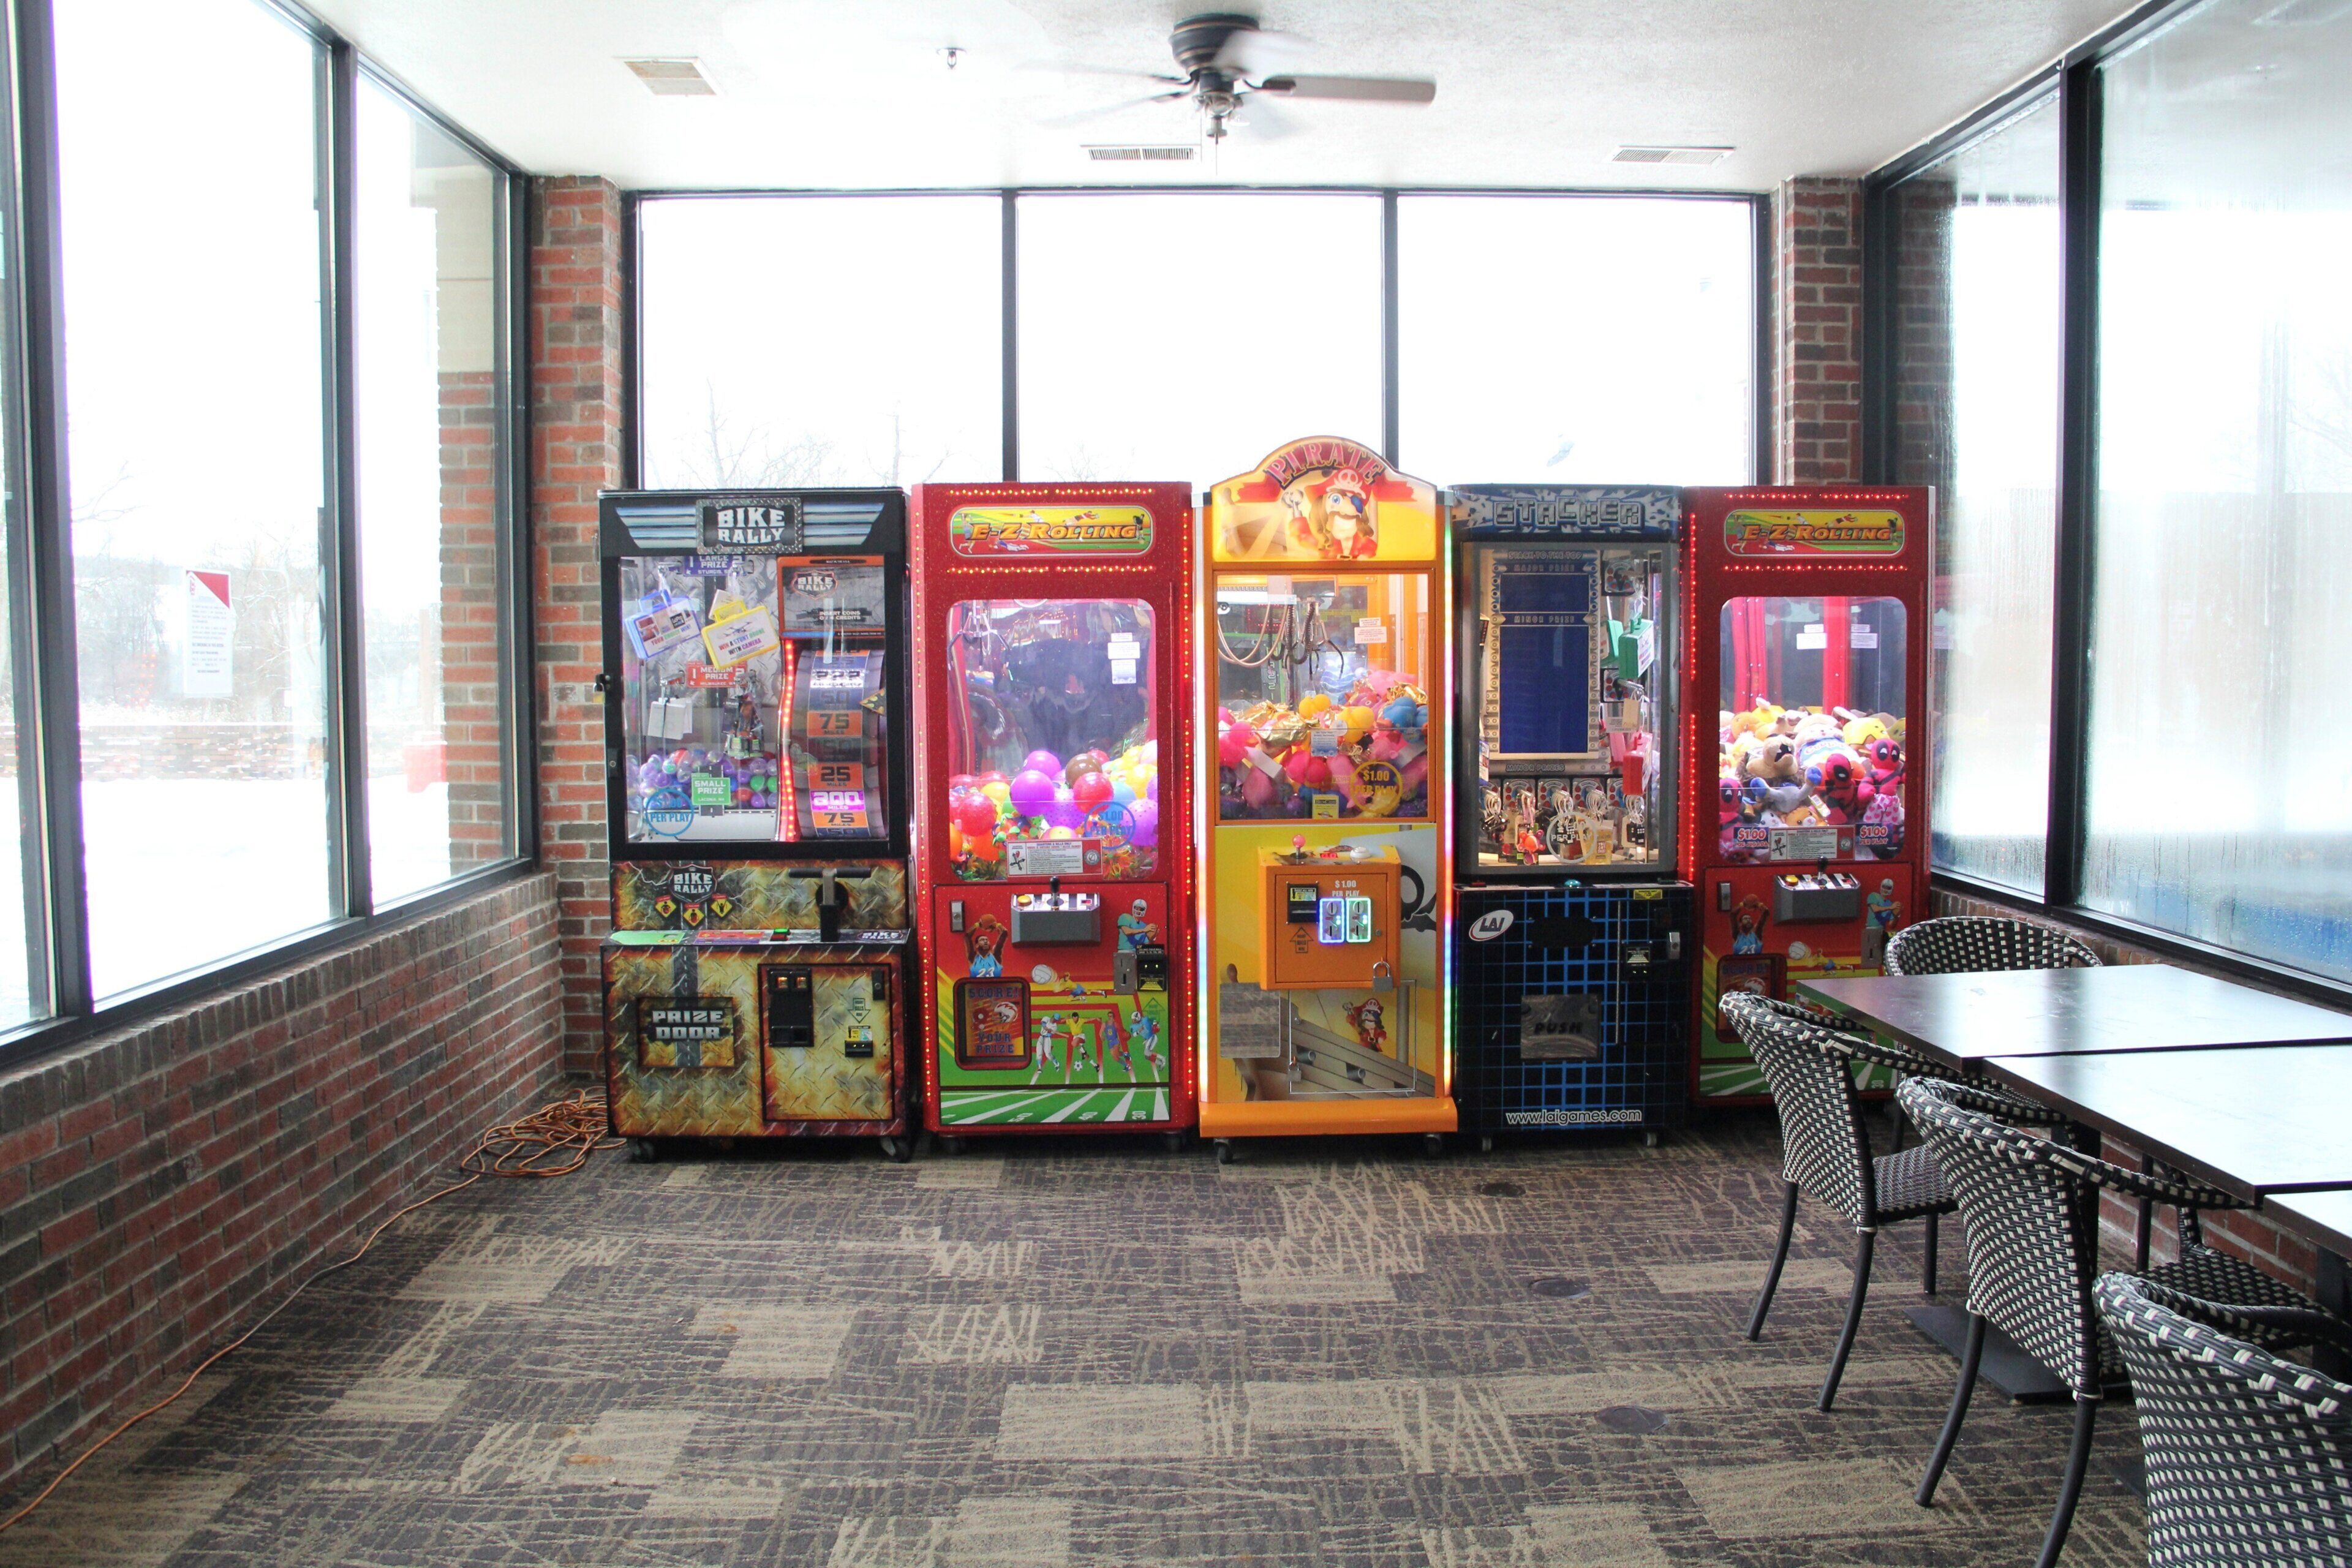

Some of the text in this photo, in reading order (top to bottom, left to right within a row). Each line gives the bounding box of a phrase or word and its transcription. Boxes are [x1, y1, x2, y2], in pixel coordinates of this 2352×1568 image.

[1265, 442, 1384, 489] PIRATE
[717, 507, 785, 527] BIKE
[1495, 497, 1642, 527] STACKER
[717, 528, 785, 543] RALLY
[969, 522, 1137, 540] E-Z ROLLING
[1741, 524, 1891, 540] E-Z ROLLING
[742, 638, 762, 649] CAMERA
[821, 690, 850, 704] 50
[820, 714, 850, 729] 75
[821, 766, 850, 782] 25
[1363, 770, 1390, 781] $1.00
[813, 791, 859, 806] 200
[650, 813, 689, 822] PER PLAY
[824, 813, 854, 823] 75
[1737, 828, 1766, 841] $1.00
[1860, 826, 1888, 839] $1.00
[673, 872, 712, 884] BIKE
[674, 884, 712, 894] RALLY
[1479, 918, 1506, 933] LAI
[976, 967, 995, 977] 23
[969, 987, 1019, 998] SCORE!
[652, 1011, 724, 1023] PRIZE
[655, 1027, 723, 1039] DOOR
[1534, 1022, 1583, 1035] PUSH
[978, 1033, 1011, 1042] YOUR
[976, 1044, 1014, 1054] PRIZE
[1506, 1109, 1642, 1126] www.laigames.com
